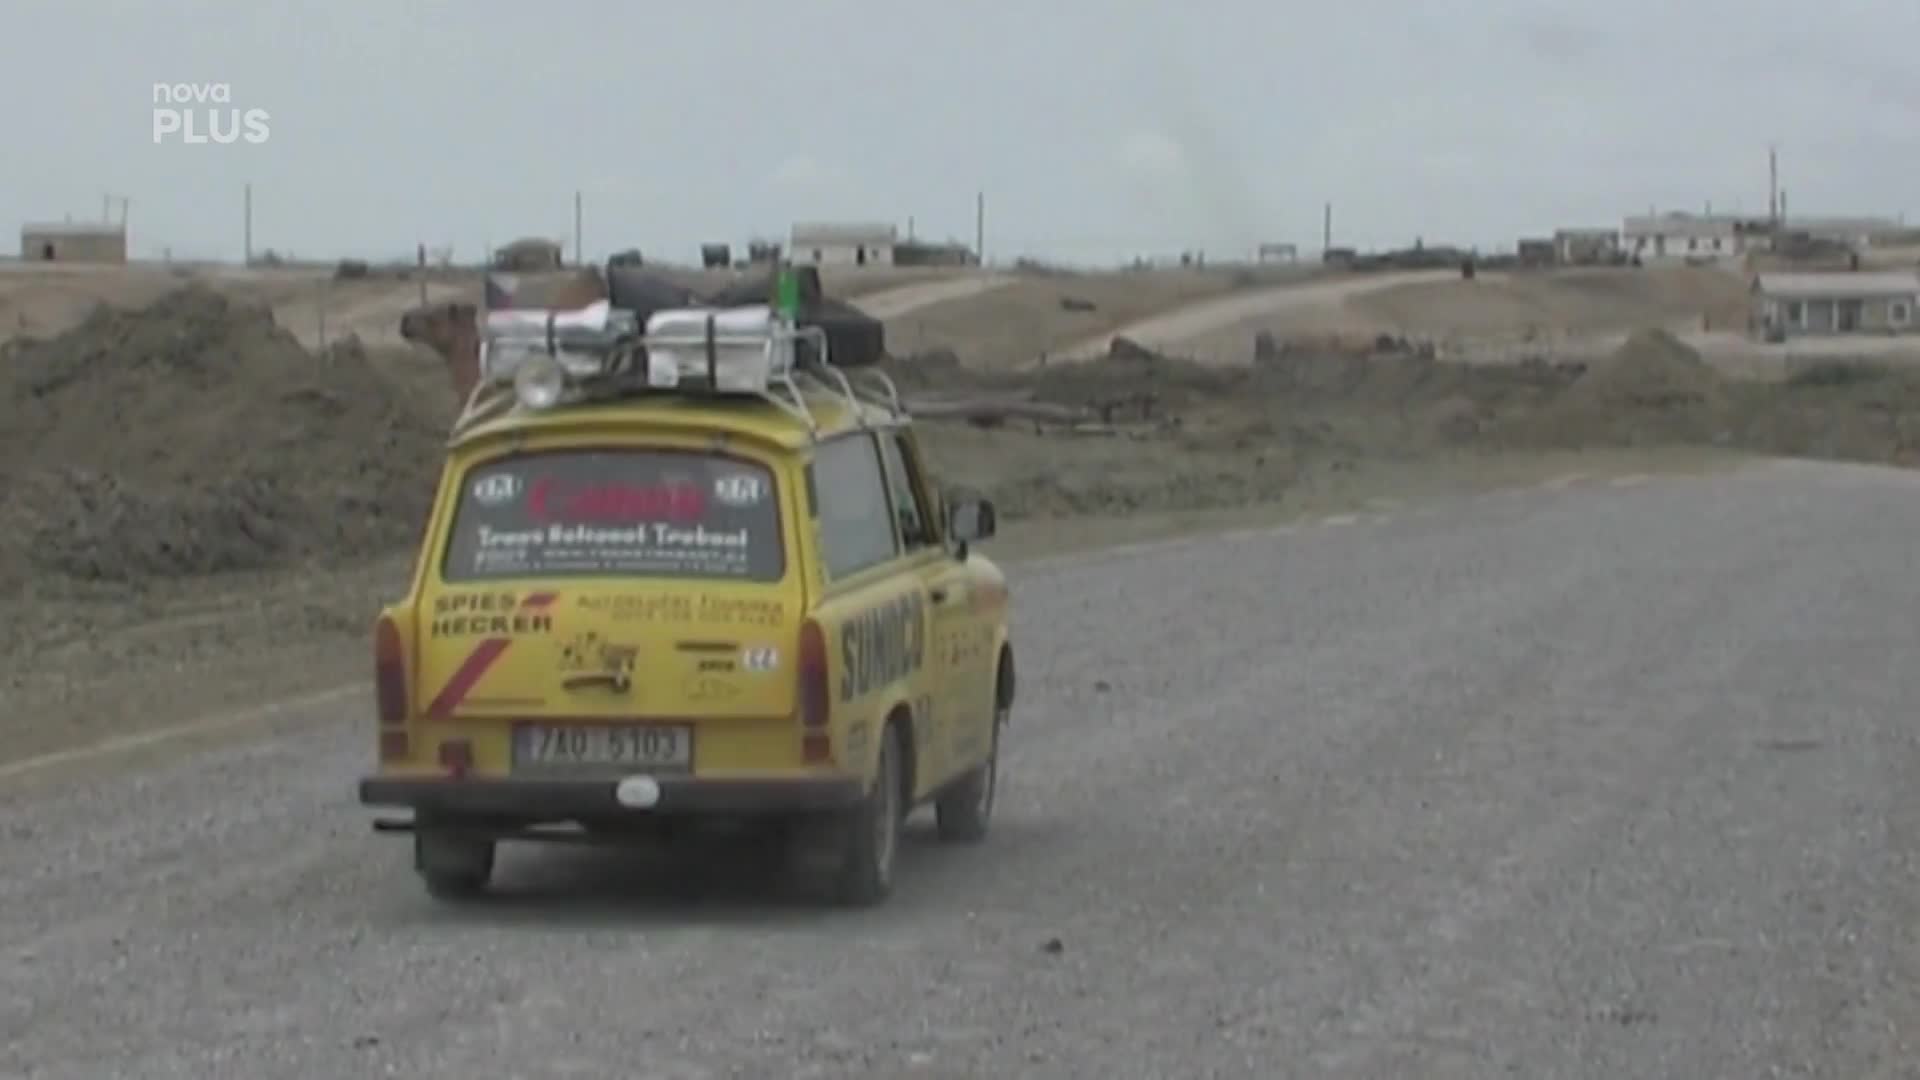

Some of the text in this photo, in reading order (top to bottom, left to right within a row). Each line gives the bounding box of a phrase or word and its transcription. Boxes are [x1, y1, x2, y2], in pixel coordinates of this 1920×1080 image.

[434, 592, 516, 614] SPIES
[432, 615, 553, 637] HECKER
[608, 726, 677, 762] 5103
